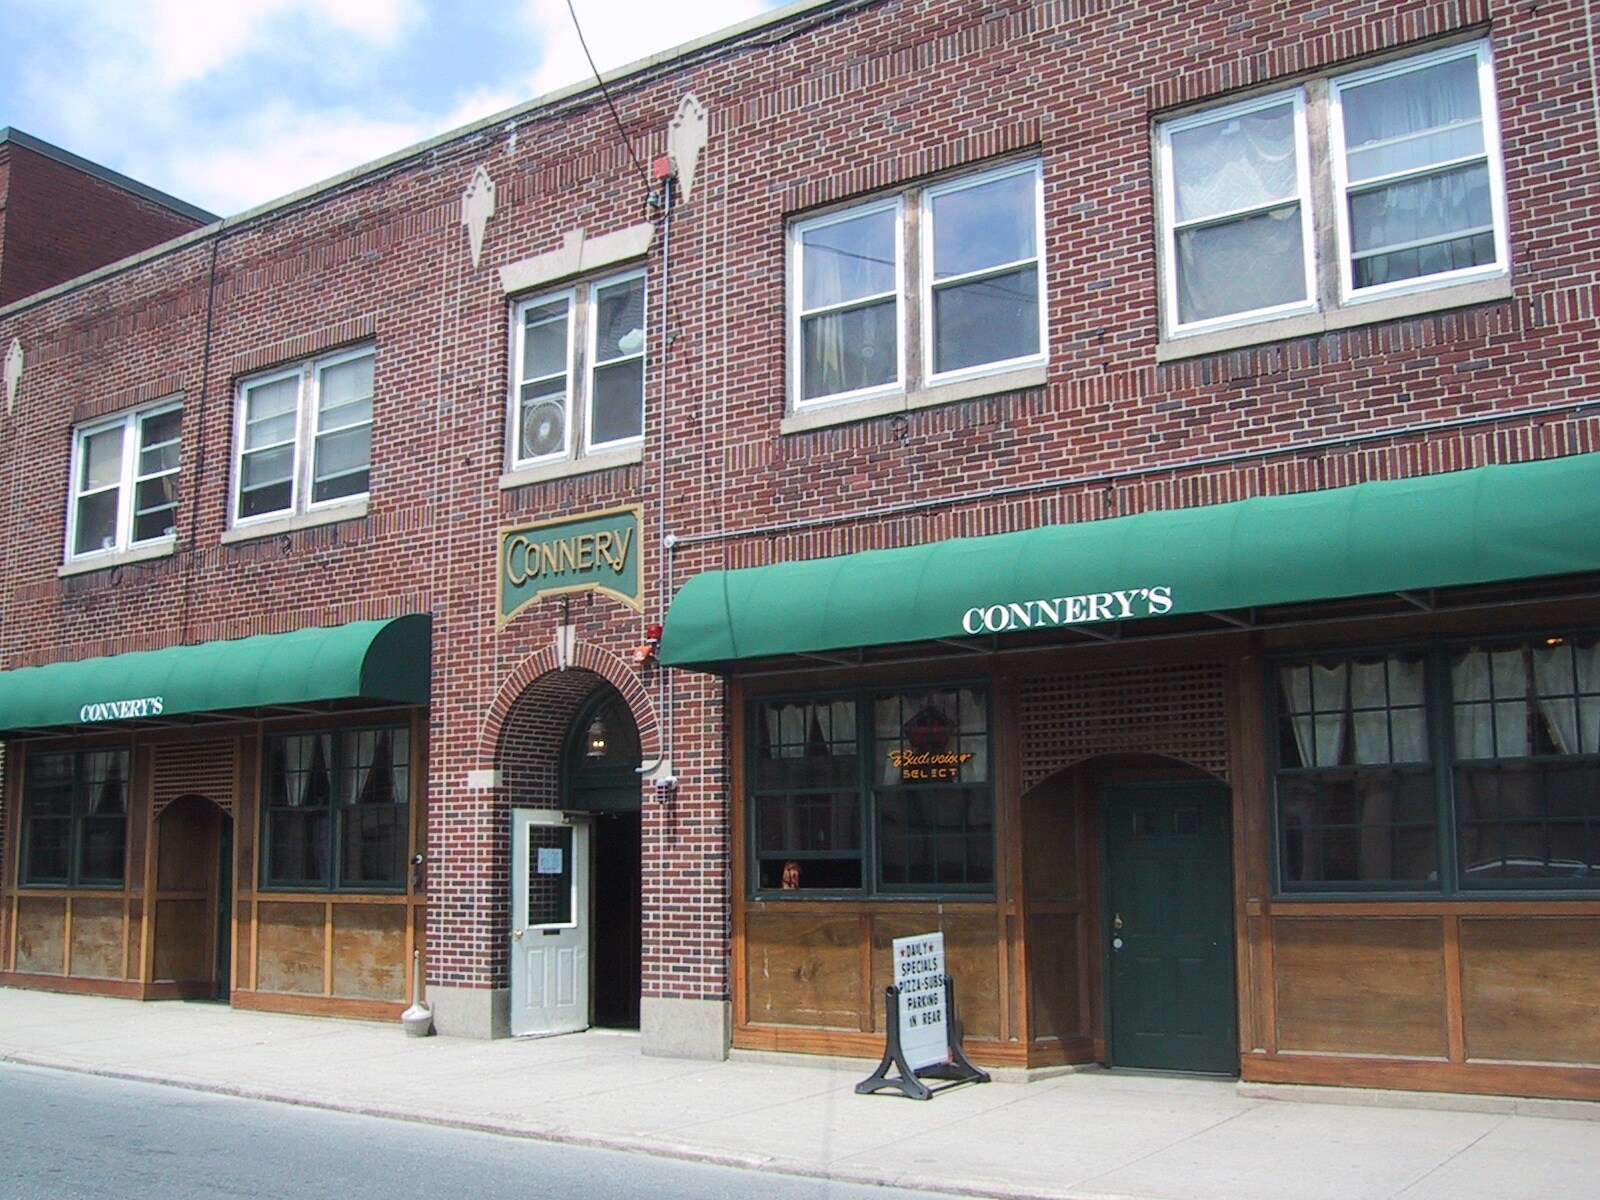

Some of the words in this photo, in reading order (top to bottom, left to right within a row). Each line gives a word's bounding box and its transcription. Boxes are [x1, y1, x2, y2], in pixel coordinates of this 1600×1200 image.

[506, 527, 633, 584] CONNERY
[962, 586, 1173, 635] CONNERY'S
[80, 696, 163, 723] CONNERY'S
[902, 768, 958, 779] SELECT
[906, 942, 927, 957] DAILY
[901, 957, 937, 976] SPECIALS
[908, 993, 938, 1011] PARKING
[909, 1014, 917, 1028] IN
[922, 1010, 941, 1025] REAR
